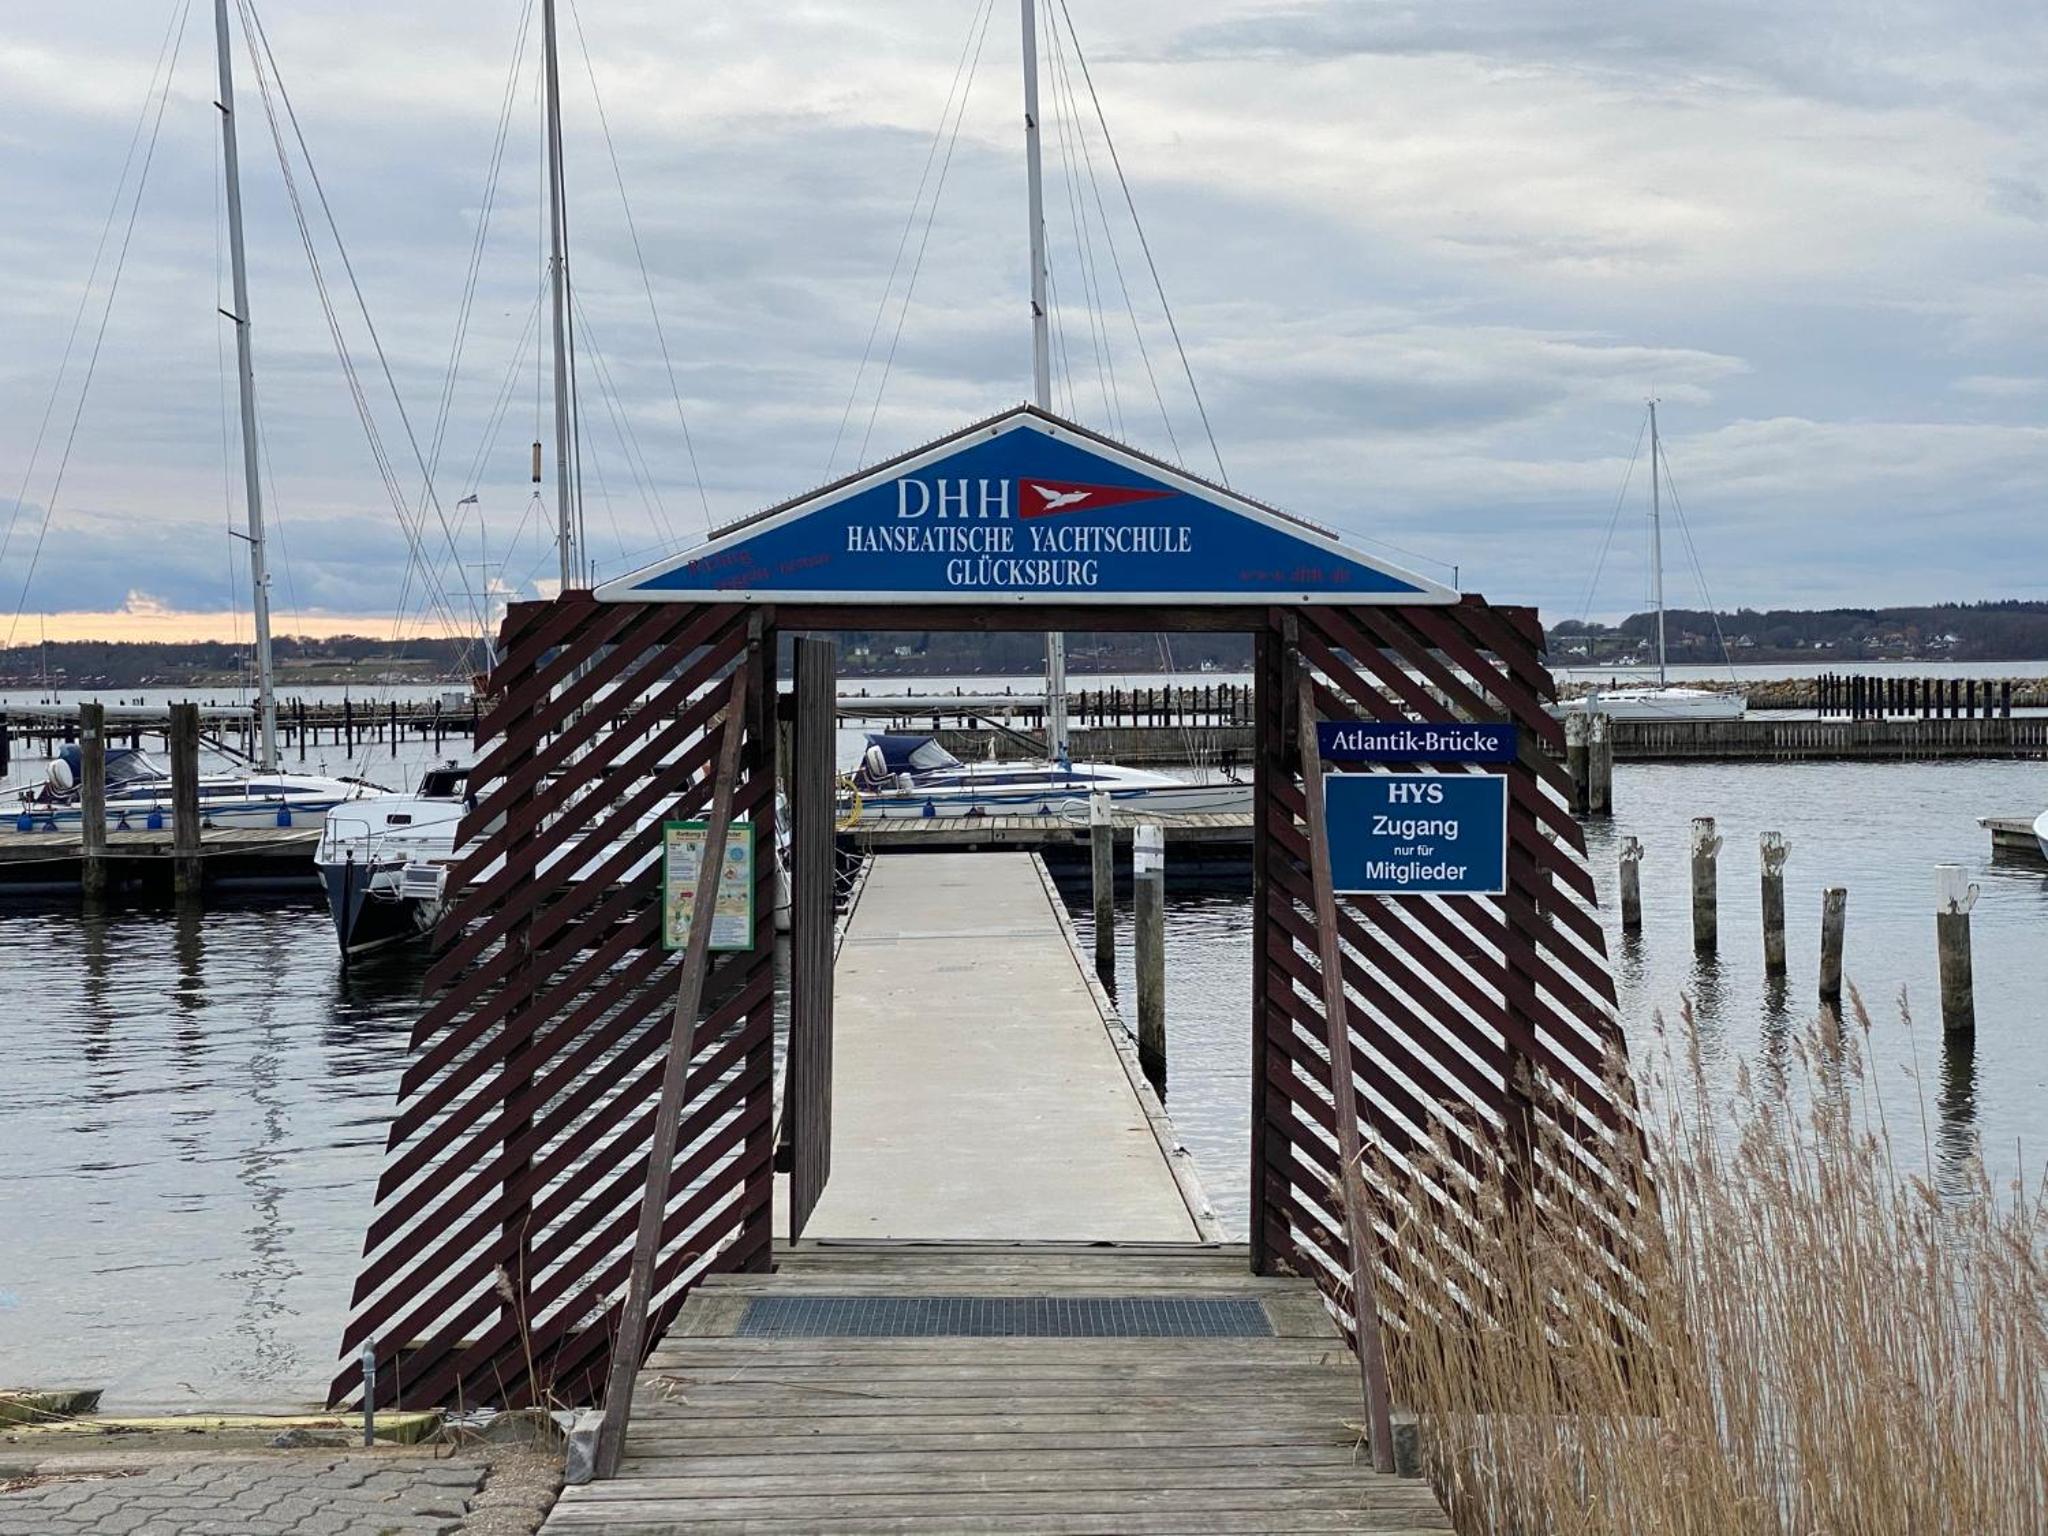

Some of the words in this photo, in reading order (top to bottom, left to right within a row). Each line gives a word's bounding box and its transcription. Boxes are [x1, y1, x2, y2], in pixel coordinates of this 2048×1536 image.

[897, 478, 1010, 519] DHH
[847, 525, 1014, 553] HANSEATISCHE
[1029, 526, 1192, 553] YACHTSCHULE
[946, 554, 1098, 586] GLÜCKSBURG
[1332, 730, 1499, 752] Atlantik-Brücke
[1388, 783, 1444, 804] HYS
[1371, 815, 1459, 841] Zugang
[1393, 846, 1414, 856] nur
[1416, 844, 1434, 856] für
[1365, 861, 1467, 884] Mitglieder
